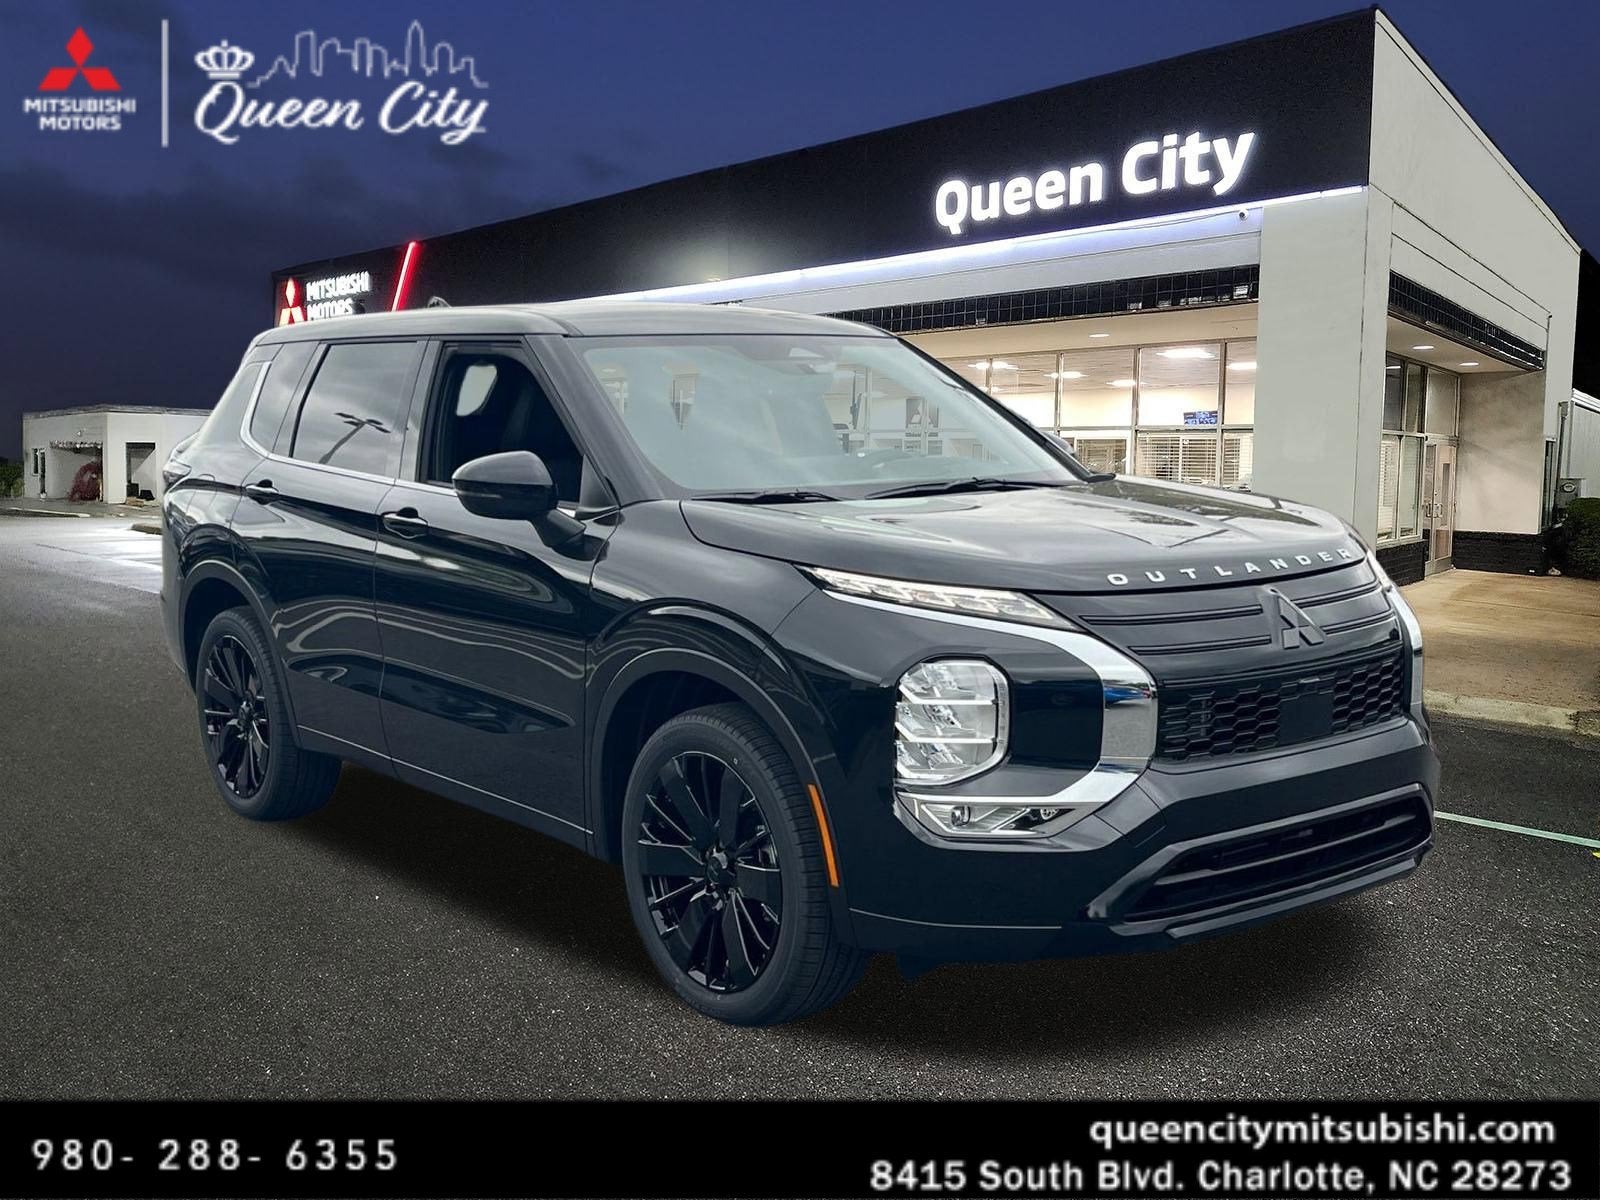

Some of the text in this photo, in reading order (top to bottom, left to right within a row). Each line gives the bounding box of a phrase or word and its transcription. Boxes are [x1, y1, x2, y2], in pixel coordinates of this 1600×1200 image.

[935, 131, 1255, 235] Queen City
[305, 271, 371, 302] MITSUBISHI
[306, 299, 354, 320] MOTORS
[1107, 549, 1351, 586] OUTLANDER
